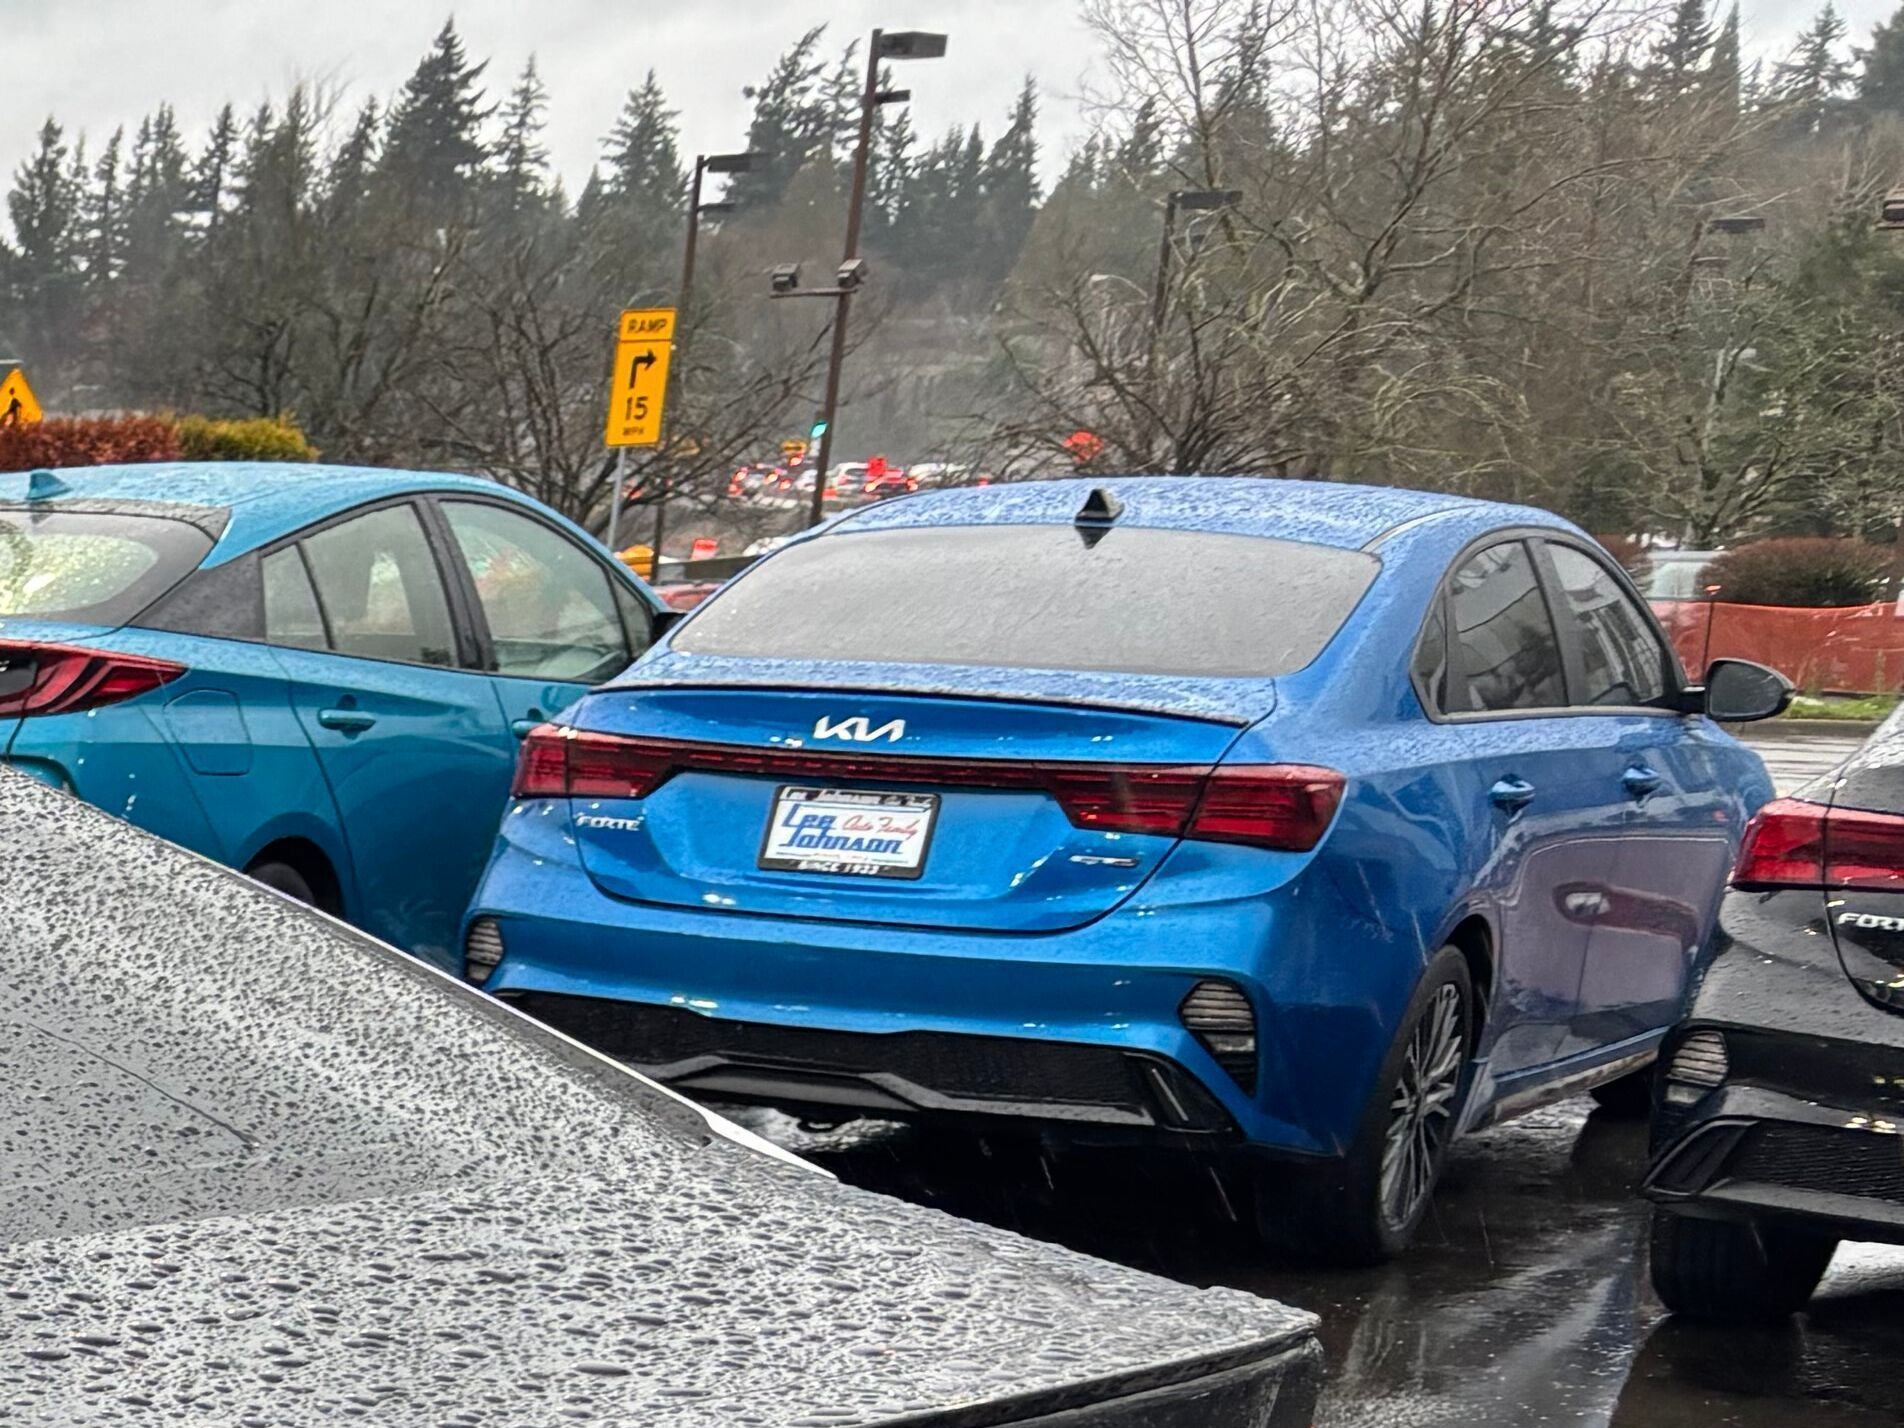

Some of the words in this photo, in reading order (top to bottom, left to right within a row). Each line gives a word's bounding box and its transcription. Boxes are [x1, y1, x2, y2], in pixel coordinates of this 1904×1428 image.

[627, 318, 667, 334] RAMP
[625, 396, 648, 421] 15
[576, 816, 641, 831] FORTE
[781, 803, 837, 830] Lee
